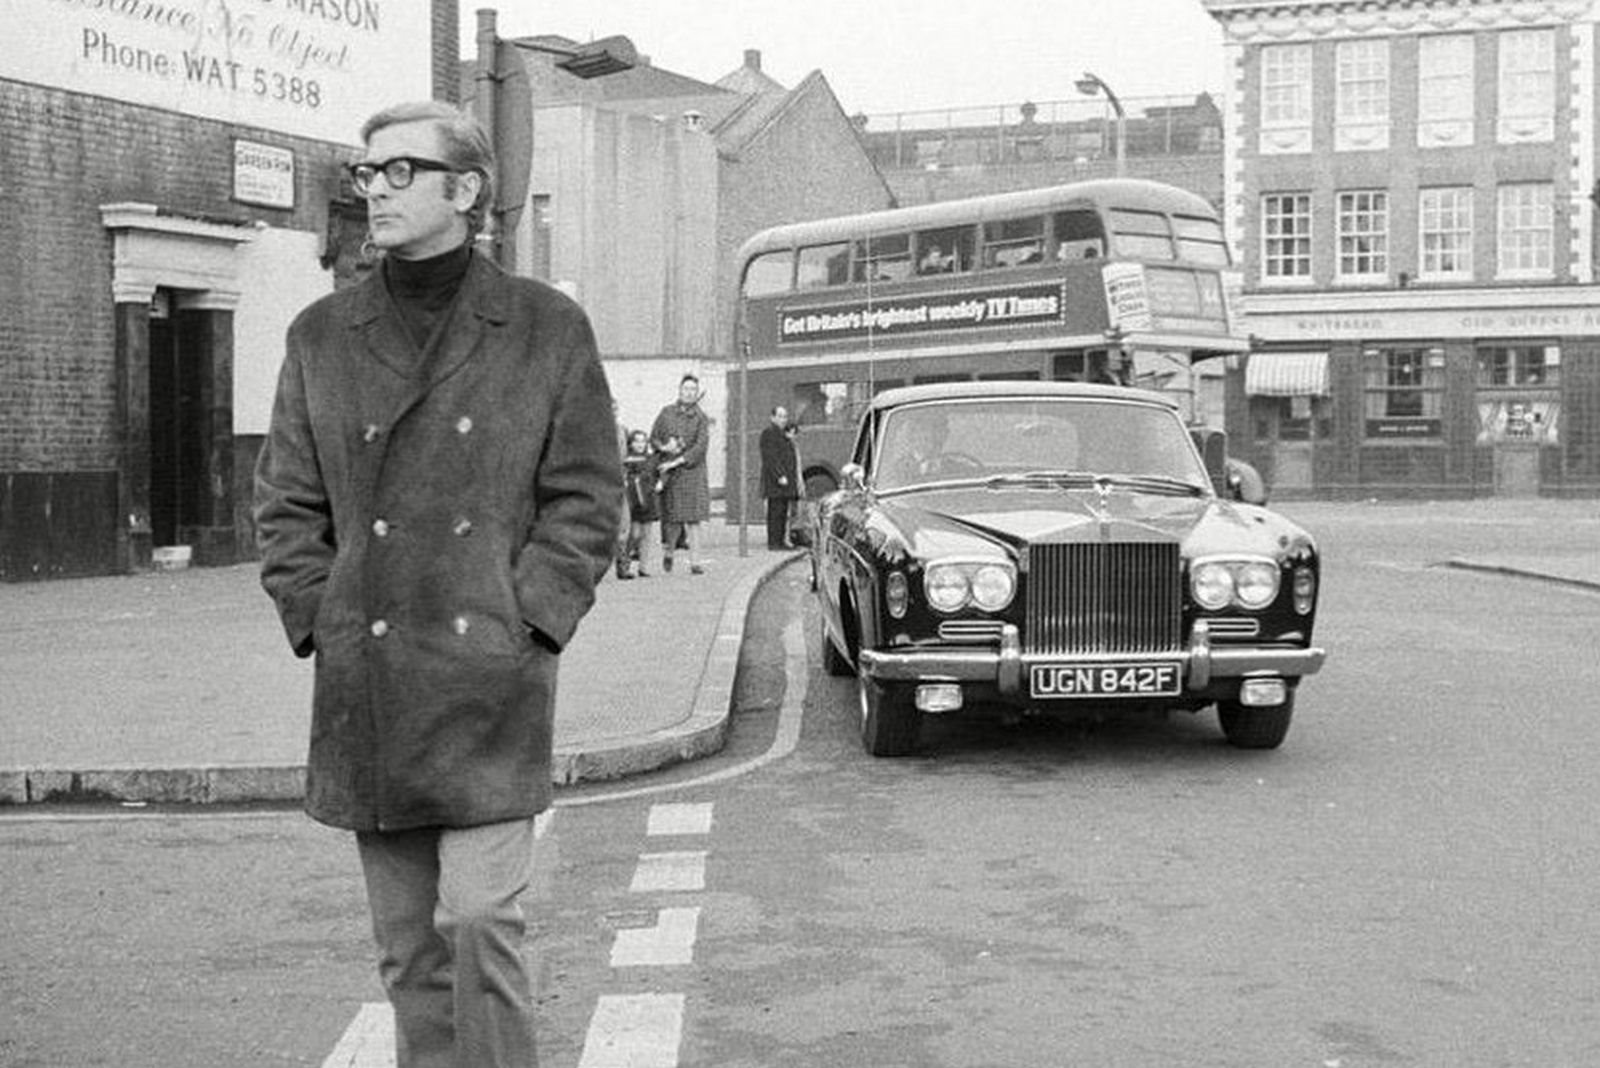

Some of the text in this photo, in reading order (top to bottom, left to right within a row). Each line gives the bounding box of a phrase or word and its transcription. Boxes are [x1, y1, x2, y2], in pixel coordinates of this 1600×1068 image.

[183, 51, 241, 91] WAT
[253, 67, 321, 108] 5388
[783, 296, 1058, 334] Get Britain's brightest weekly TV Times
[1037, 667, 1174, 692] UGN 842F
